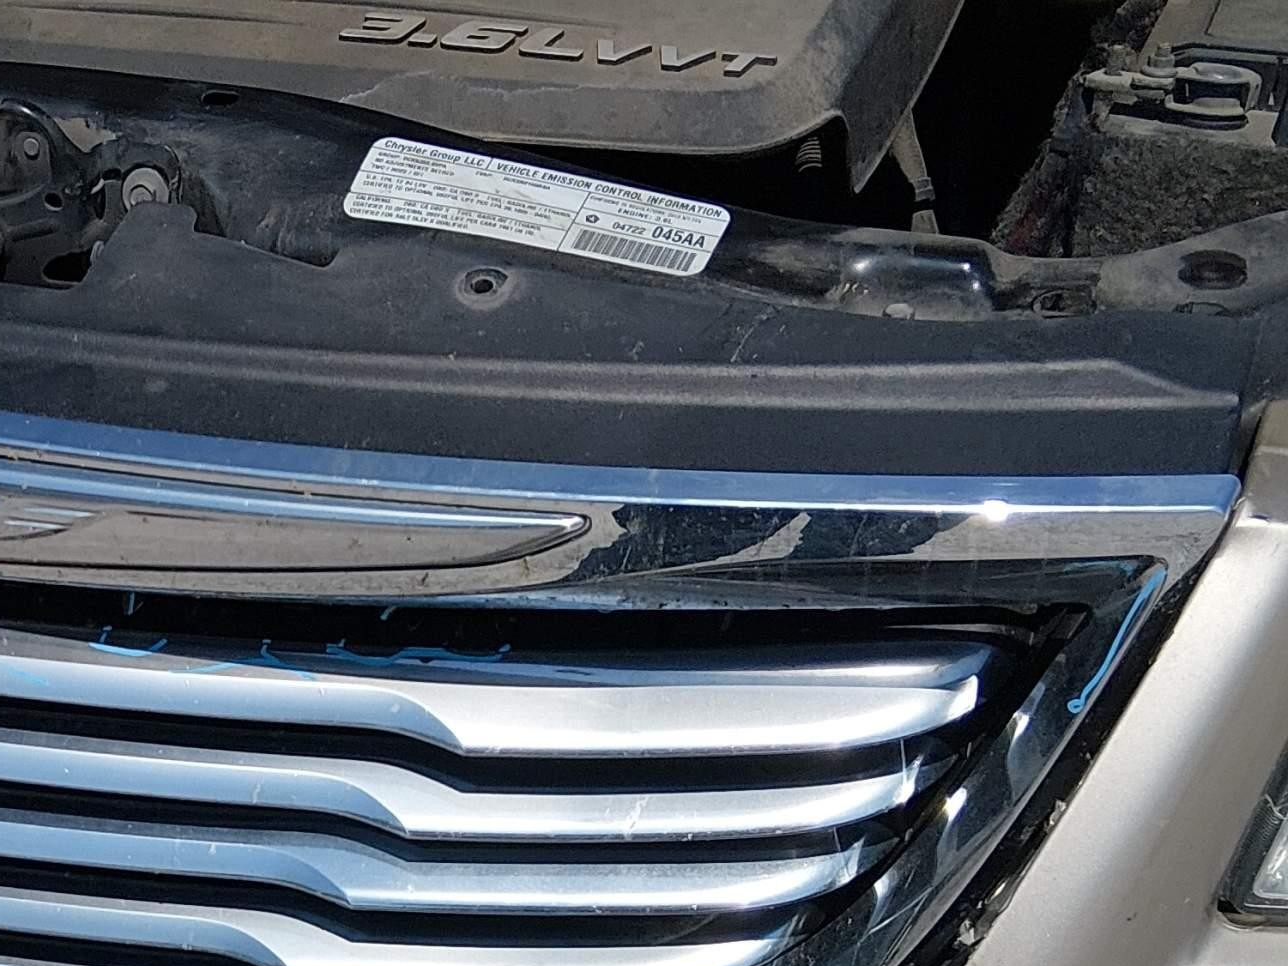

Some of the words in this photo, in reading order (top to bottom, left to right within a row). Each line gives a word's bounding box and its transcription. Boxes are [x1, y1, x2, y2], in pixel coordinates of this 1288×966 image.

[384, 140, 427, 156] Chrysler
[430, 149, 461, 164] Group
[465, 156, 484, 166] LLC
[497, 163, 538, 177] VEHICLE
[542, 172, 592, 188] EMISSION
[595, 183, 645, 200] CONTROL
[647, 195, 722, 217] INFORMATION
[613, 221, 646, 234] 04722
[652, 226, 706, 248] 045AA
